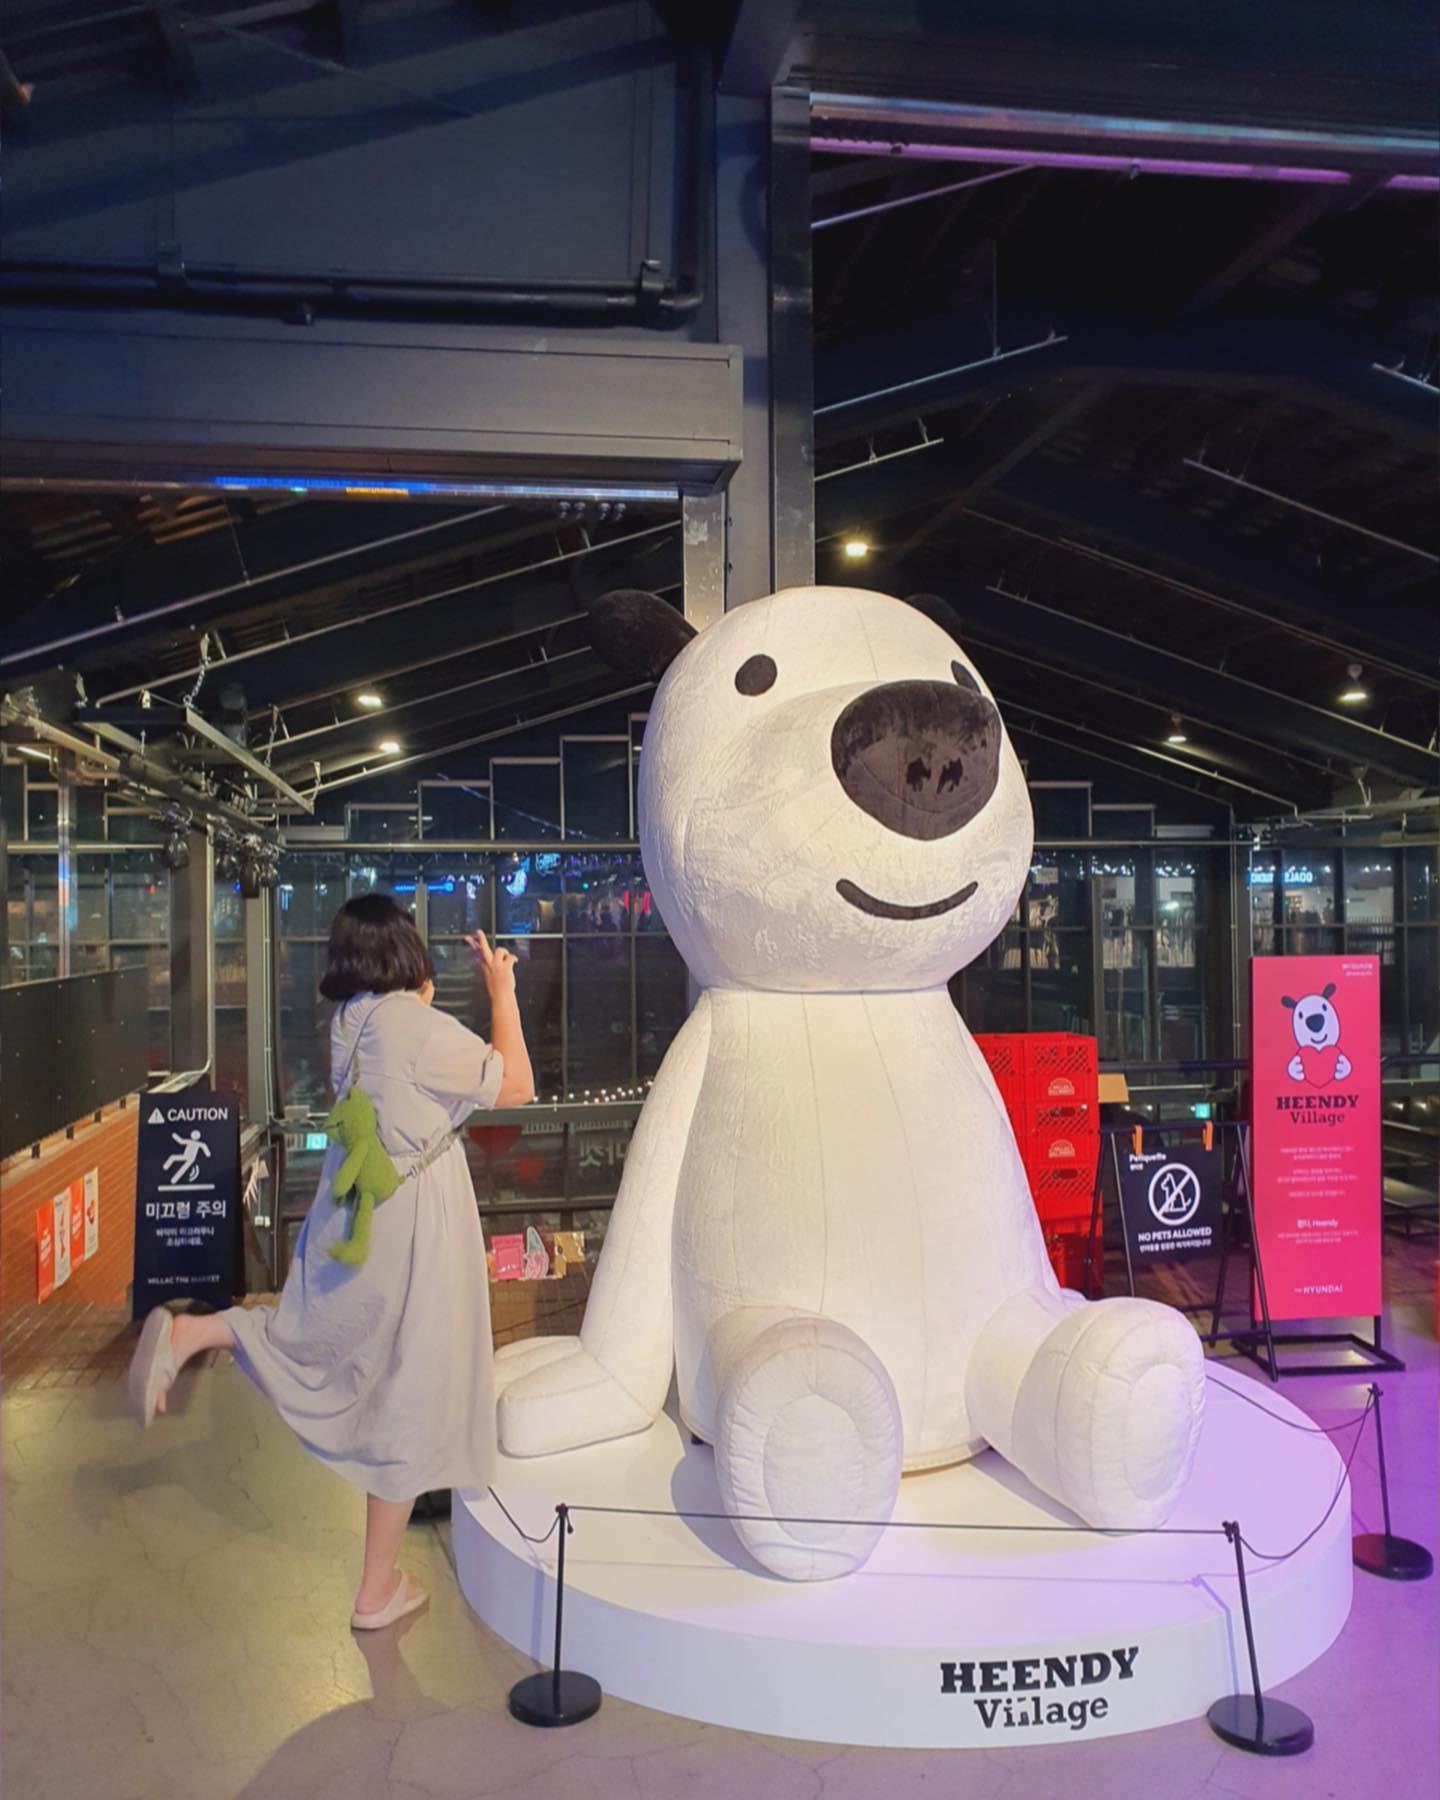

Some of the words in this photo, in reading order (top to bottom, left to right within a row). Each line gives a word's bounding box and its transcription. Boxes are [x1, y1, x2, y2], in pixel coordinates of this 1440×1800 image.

[1276, 1094, 1359, 1110] HEENDY
[167, 1107, 228, 1121] CAUTION
[1290, 1111, 1345, 1126] Village
[145, 1200, 191, 1220] 미끄럼
[196, 1199, 227, 1219] 주의
[1138, 1232, 1151, 1243] NO
[1152, 1229, 1172, 1241] PETS
[1173, 1226, 1212, 1239] ALLOWED
[1303, 1283, 1344, 1294] HYUNDAI
[940, 1646, 1139, 1694] HEENDY
